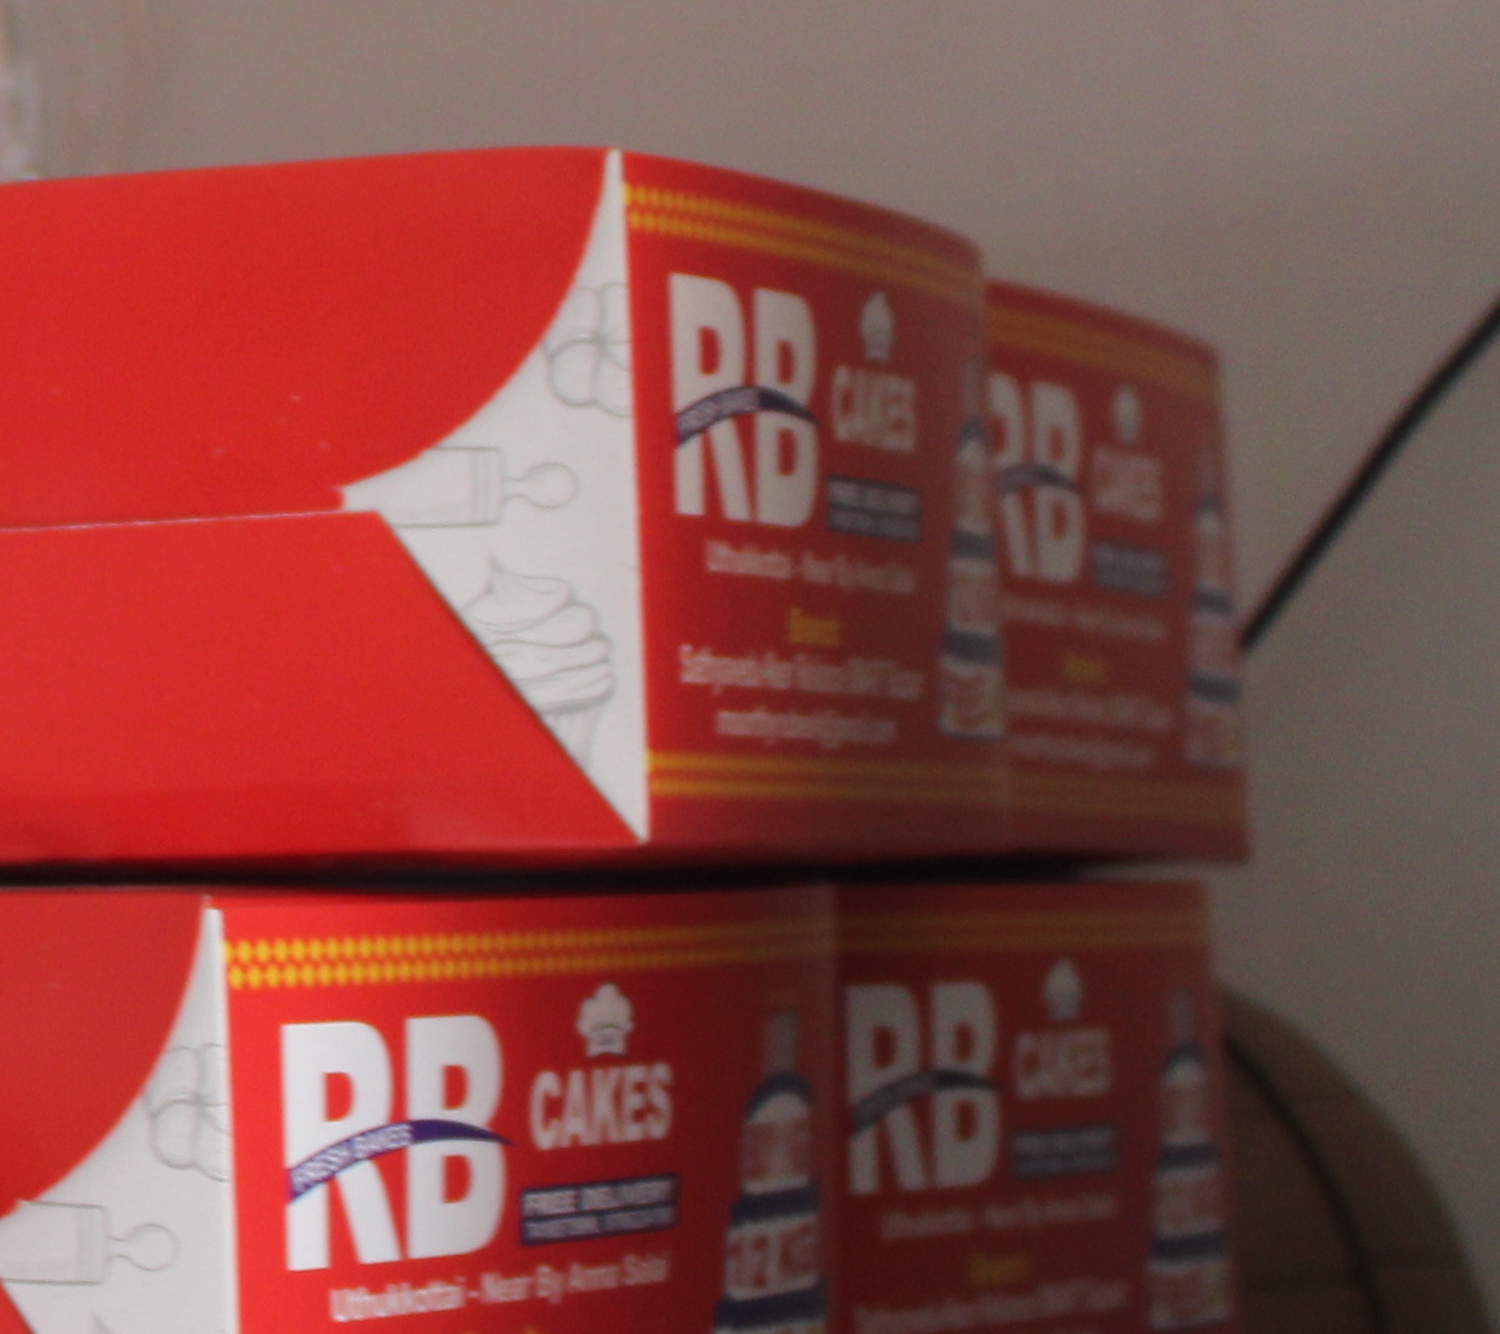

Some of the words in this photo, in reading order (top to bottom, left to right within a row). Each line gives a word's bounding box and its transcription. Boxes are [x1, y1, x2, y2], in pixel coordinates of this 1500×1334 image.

[667, 271, 819, 528] RB
[280, 1013, 507, 1272] RB
[527, 1061, 674, 1152] CAKES
[844, 980, 1001, 1196] RB
